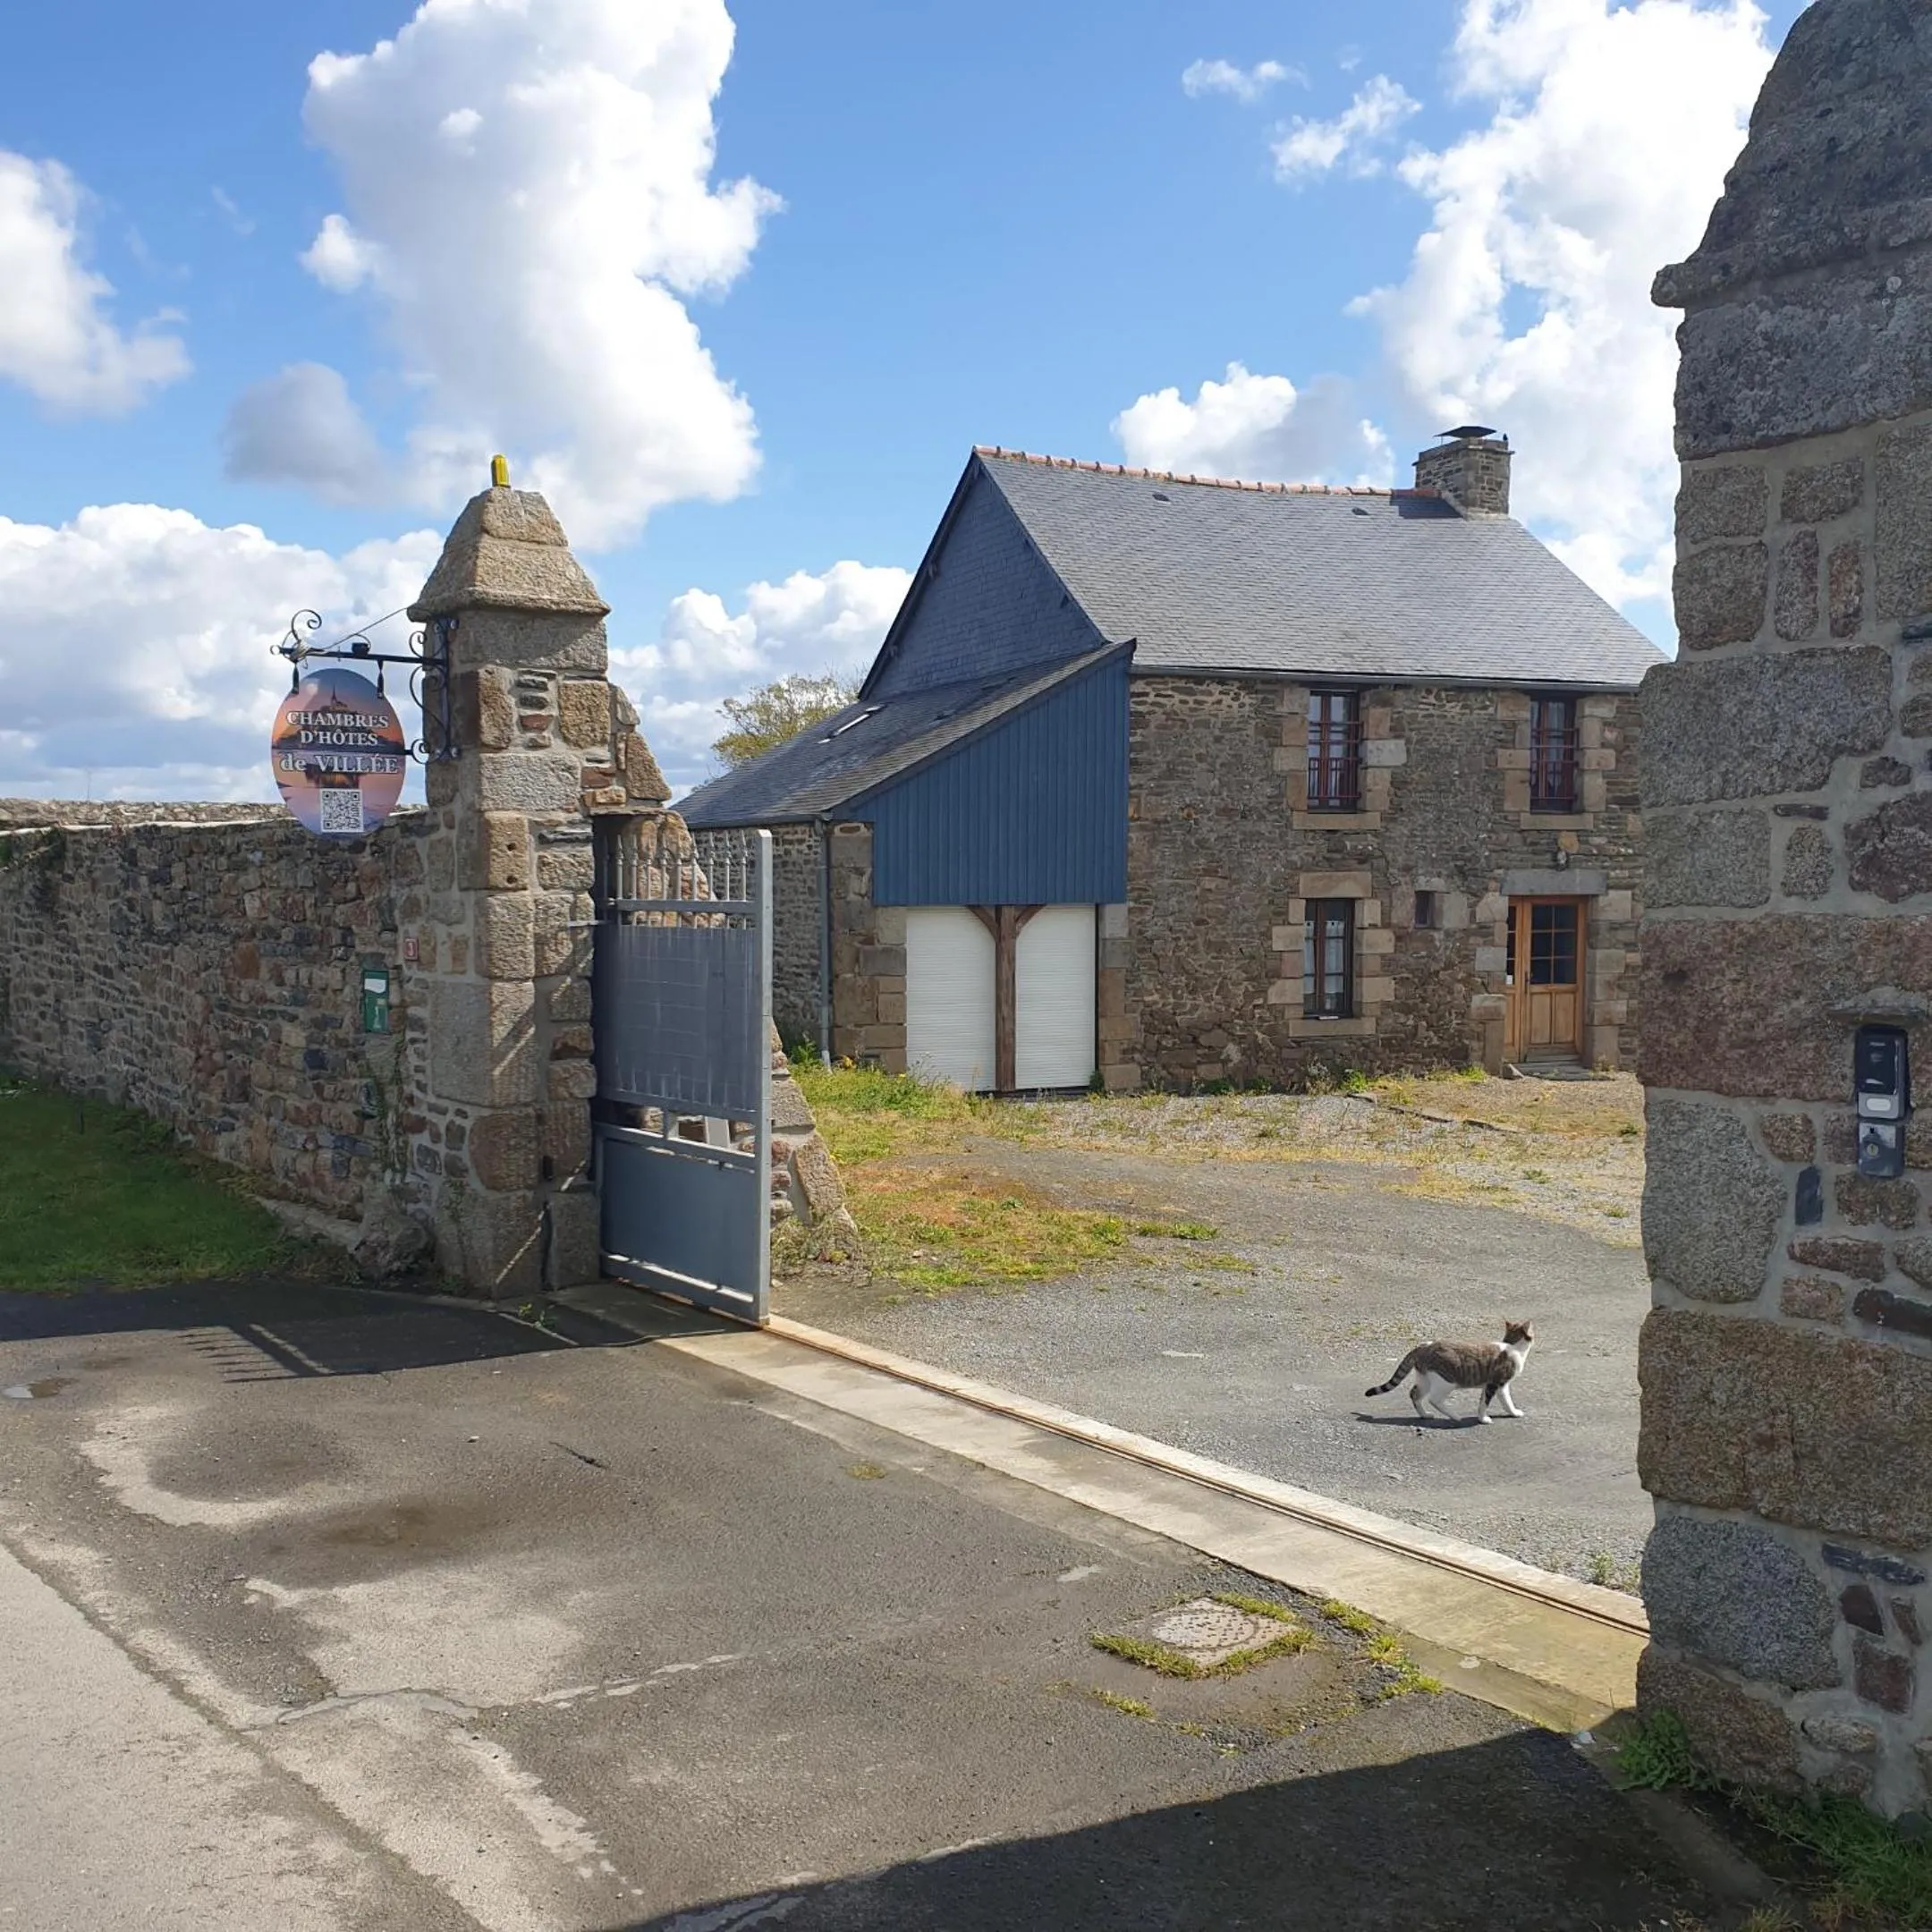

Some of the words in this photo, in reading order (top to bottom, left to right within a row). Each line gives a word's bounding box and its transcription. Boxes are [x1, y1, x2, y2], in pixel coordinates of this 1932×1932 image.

[286, 711, 389, 727] CHAMBRES
[301, 729, 378, 746] D'HÔTES
[280, 753, 307, 772] de
[315, 754, 399, 774] VILLÉE
